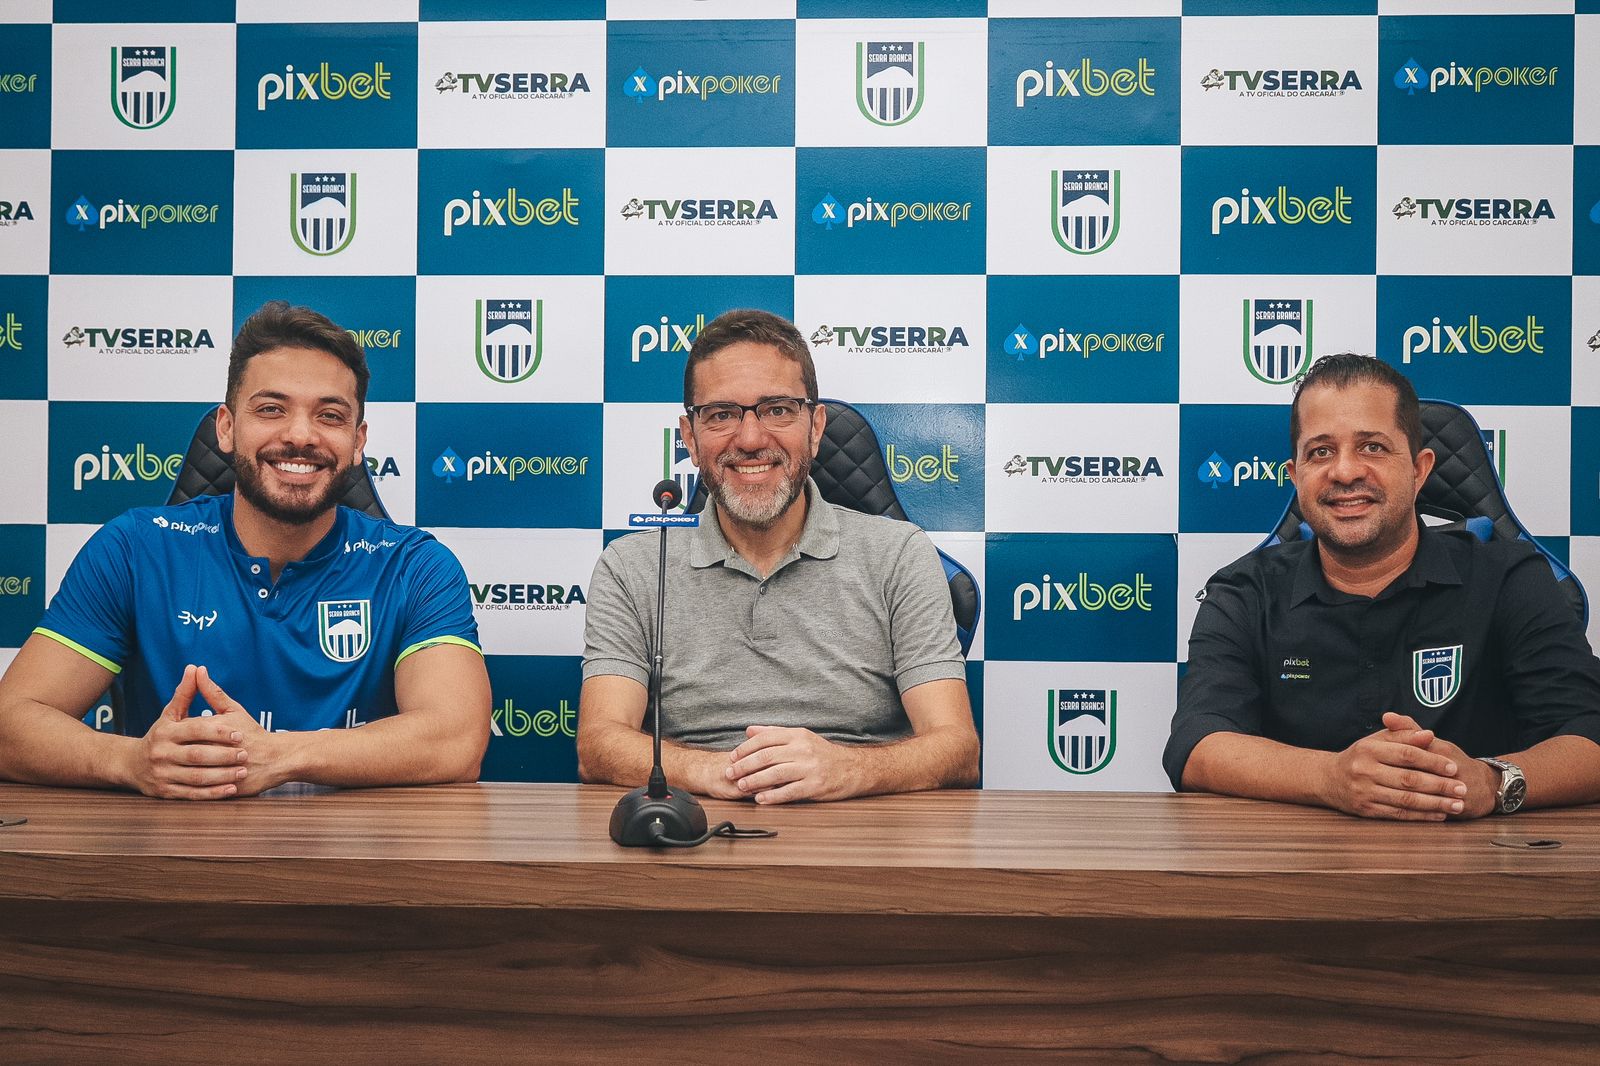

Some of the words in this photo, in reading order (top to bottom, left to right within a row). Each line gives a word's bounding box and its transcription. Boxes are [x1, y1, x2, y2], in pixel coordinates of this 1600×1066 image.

[122, 58, 141, 67] SERRA
[142, 58, 165, 67] BRANCA
[868, 53, 888, 63] SERRA
[889, 53, 912, 63] BRANCA
[257, 62, 391, 111] pixbet
[658, 69, 781, 100] pixpoker
[1017, 58, 1155, 107] pixbet
[1430, 61, 1558, 93] pixpoker
[302, 184, 321, 193] SERRA
[322, 184, 345, 193] BRANCA
[1063, 181, 1083, 191] SERRA
[1084, 181, 1108, 191] BRANCA
[100, 199, 219, 229] pixpoker
[443, 188, 579, 236] pixbet
[847, 197, 972, 228] pixpoker
[1211, 186, 1352, 235] pixbet
[488, 311, 507, 320] SERRA
[507, 311, 530, 320] BRANCA
[1255, 311, 1275, 320] SERRA
[1276, 311, 1300, 320] BRANCA
[1040, 328, 1164, 358] pixpoker
[1402, 315, 1544, 364] pixbet
[73, 443, 183, 491] pixbe
[467, 451, 588, 481] pixpoker
[886, 445, 959, 483] bet
[469, 584, 587, 604] VSERRA
[1013, 573, 1152, 621] pixbet
[1060, 701, 1080, 710] SERRA
[1080, 701, 1105, 710] BRANCA
